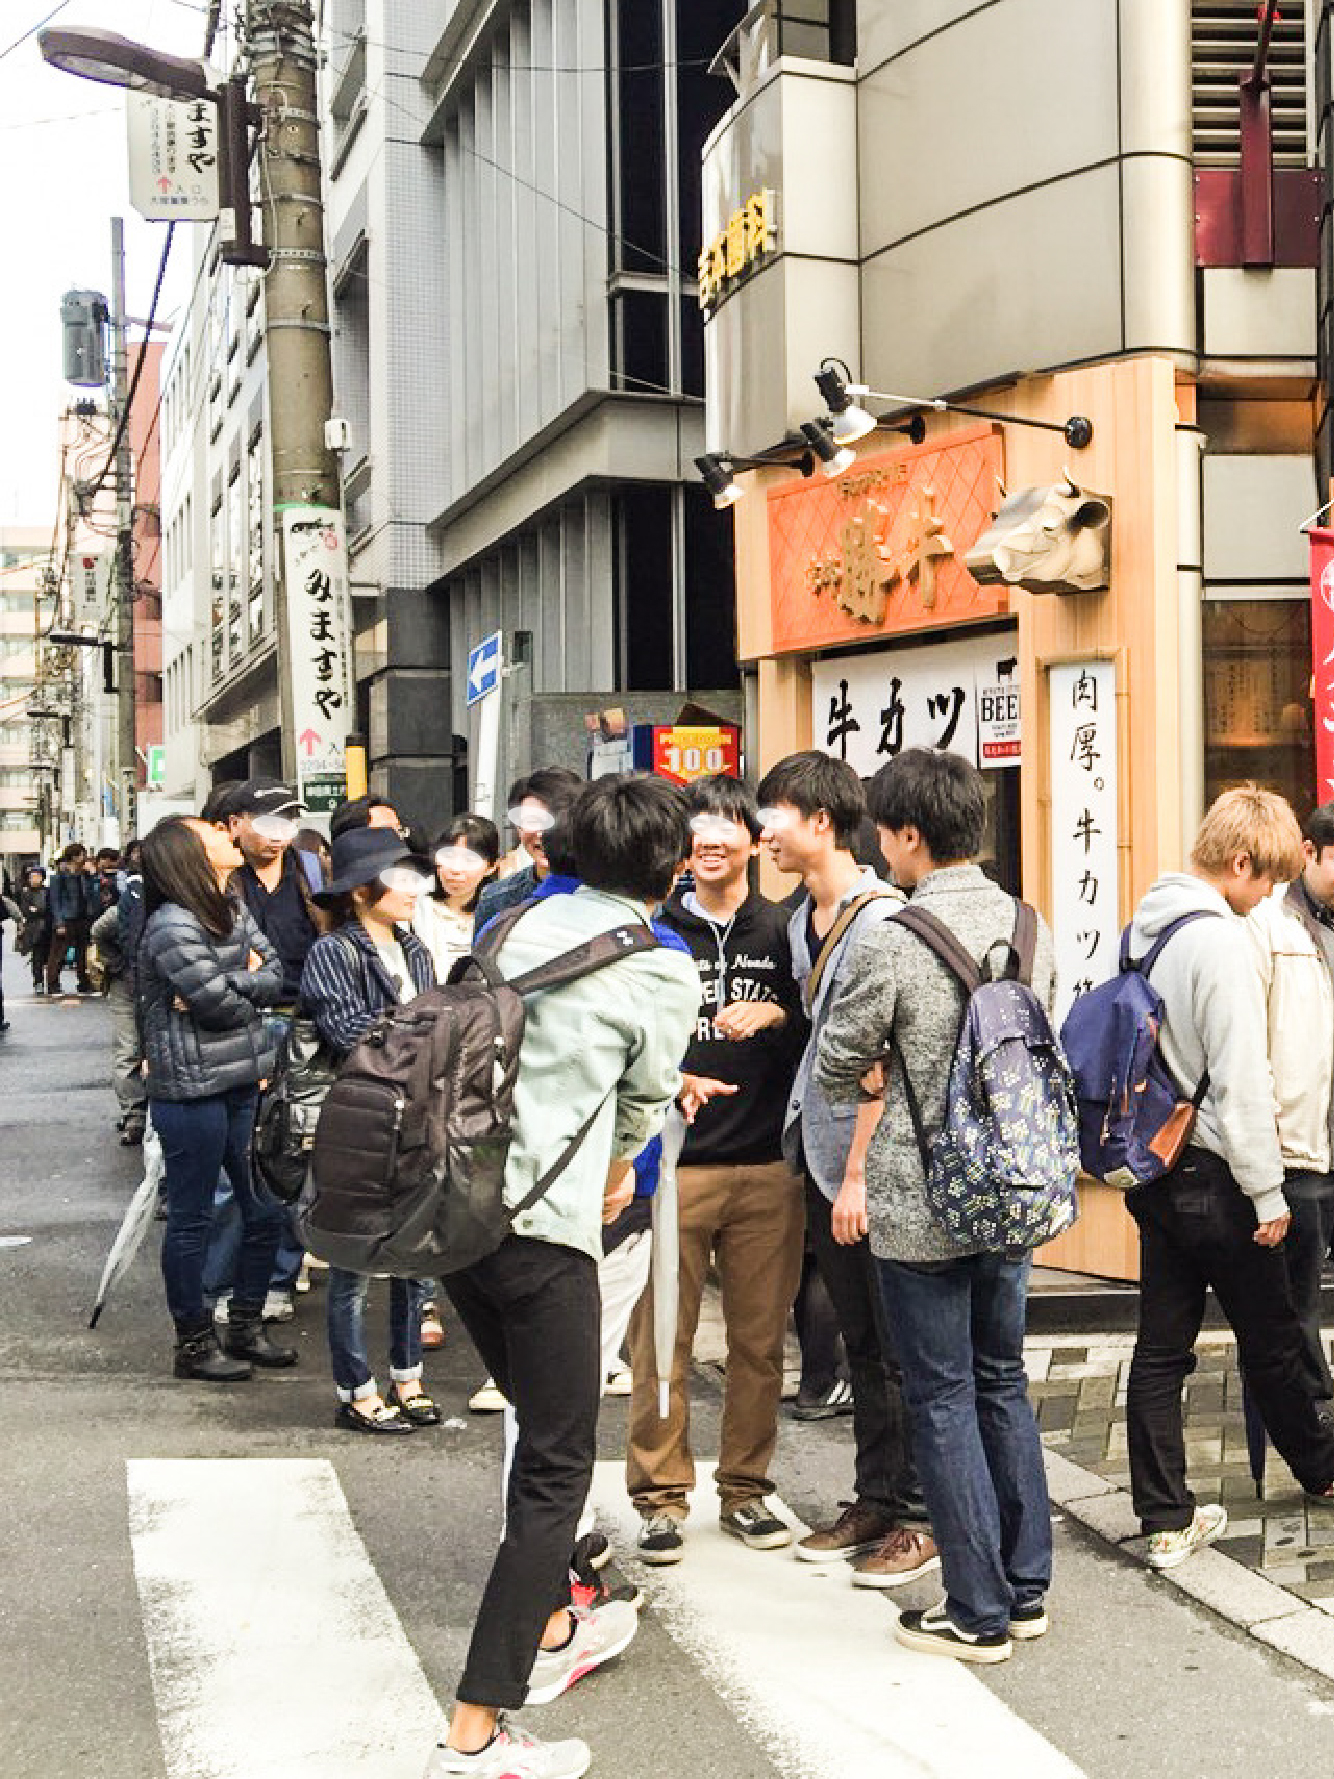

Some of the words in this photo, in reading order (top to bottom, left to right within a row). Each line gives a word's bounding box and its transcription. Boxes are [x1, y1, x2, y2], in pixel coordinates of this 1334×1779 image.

[304, 568, 343, 721] みますや
[826, 676, 966, 761] 牛カツ
[980, 693, 1021, 722] BEE
[664, 746, 723, 773] 100
